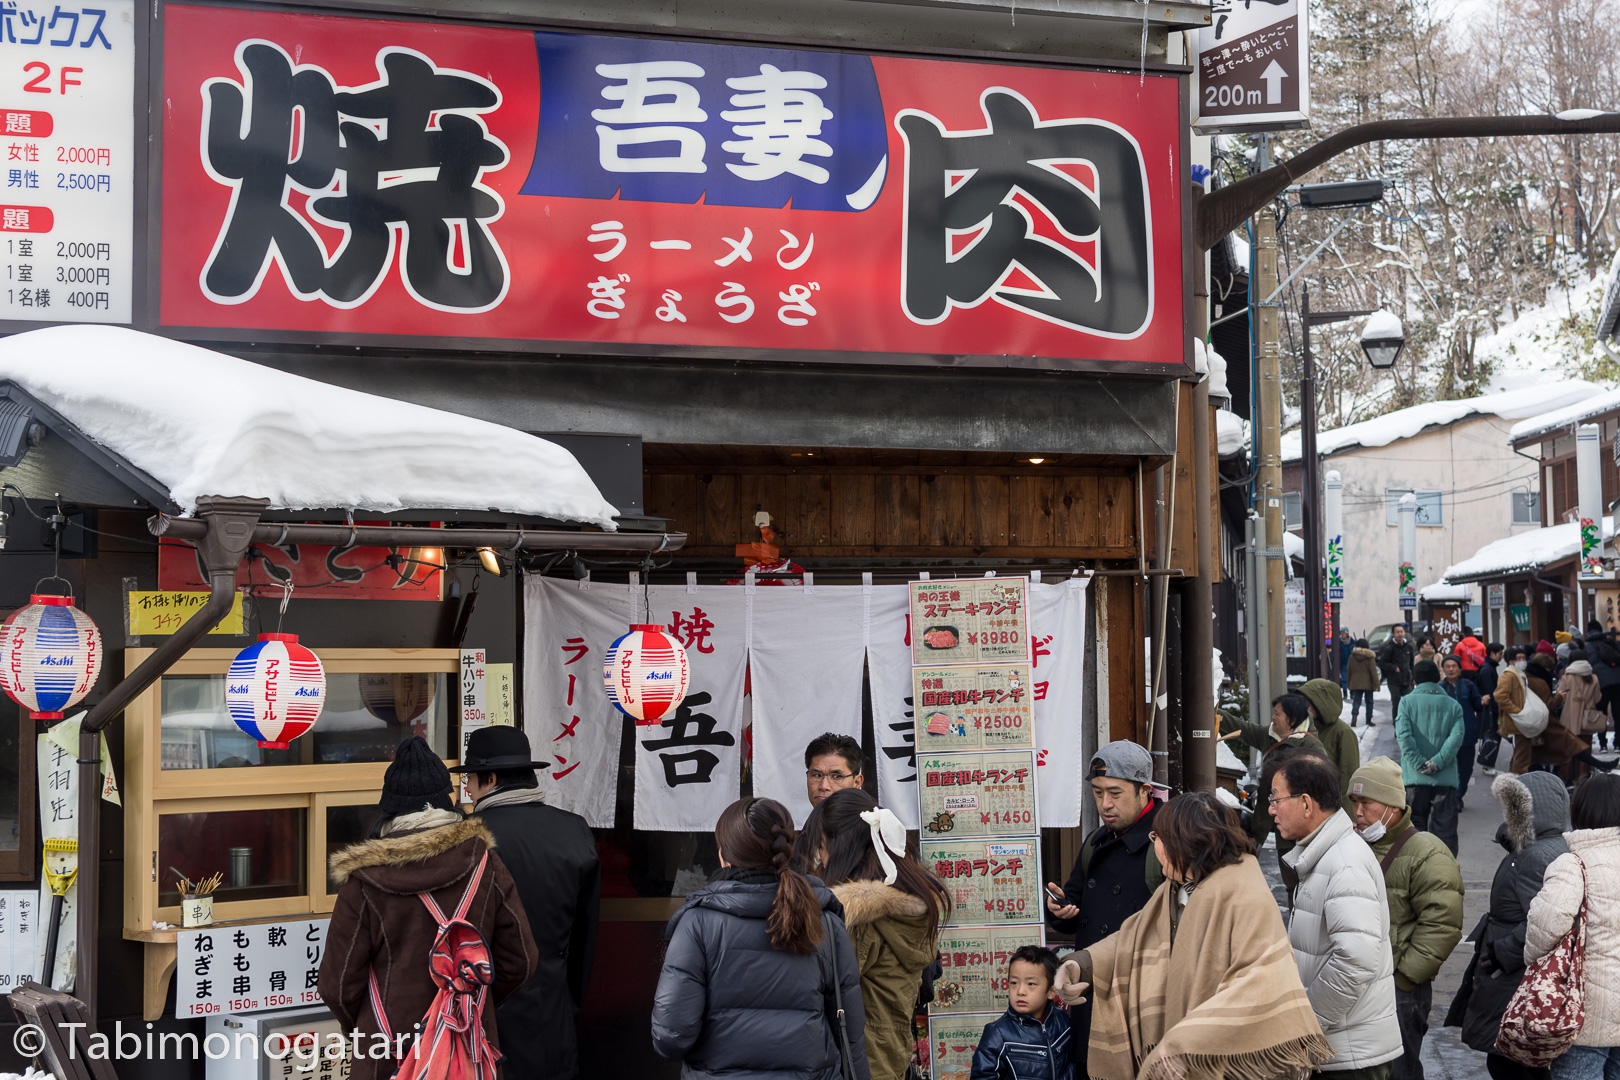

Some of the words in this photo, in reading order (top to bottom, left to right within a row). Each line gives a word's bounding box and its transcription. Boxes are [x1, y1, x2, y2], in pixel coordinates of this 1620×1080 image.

[22, 61, 84, 95] 2F
[1205, 84, 1262, 107] 200m
[591, 60, 834, 185] 吾妻
[7, 142, 40, 163] 女性
[56, 146, 111, 167] 2,000円
[7, 169, 40, 189] 男性
[56, 173, 111, 193] 2,500円
[200, 38, 511, 313] 焼
[894, 86, 1155, 340] 肉
[56, 242, 111, 262] 2,000円
[586, 220, 815, 271] ラーメン
[55, 266, 110, 286] 3,000円
[7, 289, 51, 308] 1名様
[66, 291, 110, 310] 400円
[586, 273, 821, 327] ぎょうざ
[924, 601, 1021, 618] ステーキランチ
[667, 607, 715, 654] 焼
[967, 630, 1019, 645] ¥3980
[11, 627, 27, 692] アサヒビール
[40, 654, 74, 667] Asahi
[76, 629, 96, 693] アサヒビール
[475, 652, 485, 679] 和牛
[462, 655, 476, 708] 牛ハツ串
[621, 650, 635, 704] アサヒビール
[646, 671, 673, 680] Asahi
[263, 659, 280, 720] アサヒビール
[294, 686, 320, 697] Asahi
[922, 688, 1025, 706] 国産和牛ランチ
[464, 709, 486, 720] 350円
[553, 637, 590, 781] ラーメン
[973, 715, 1023, 729] ¥2500
[641, 691, 736, 788] 吾
[924, 760, 961, 768] 人気メニュー
[926, 768, 1029, 787] 国産和牛ランチ
[980, 810, 1031, 825] ¥1450
[930, 851, 967, 859] 人気メニュー
[935, 857, 1024, 878] 焼肉ランチ
[984, 898, 1026, 913] ¥950
[194, 933, 213, 999] ねぎま
[233, 929, 250, 996] もも串
[267, 926, 287, 992] 軟骨
[189, 1002, 220, 1015] 150円
[228, 998, 258, 1010] 150円
[264, 994, 292, 1006] 150円
